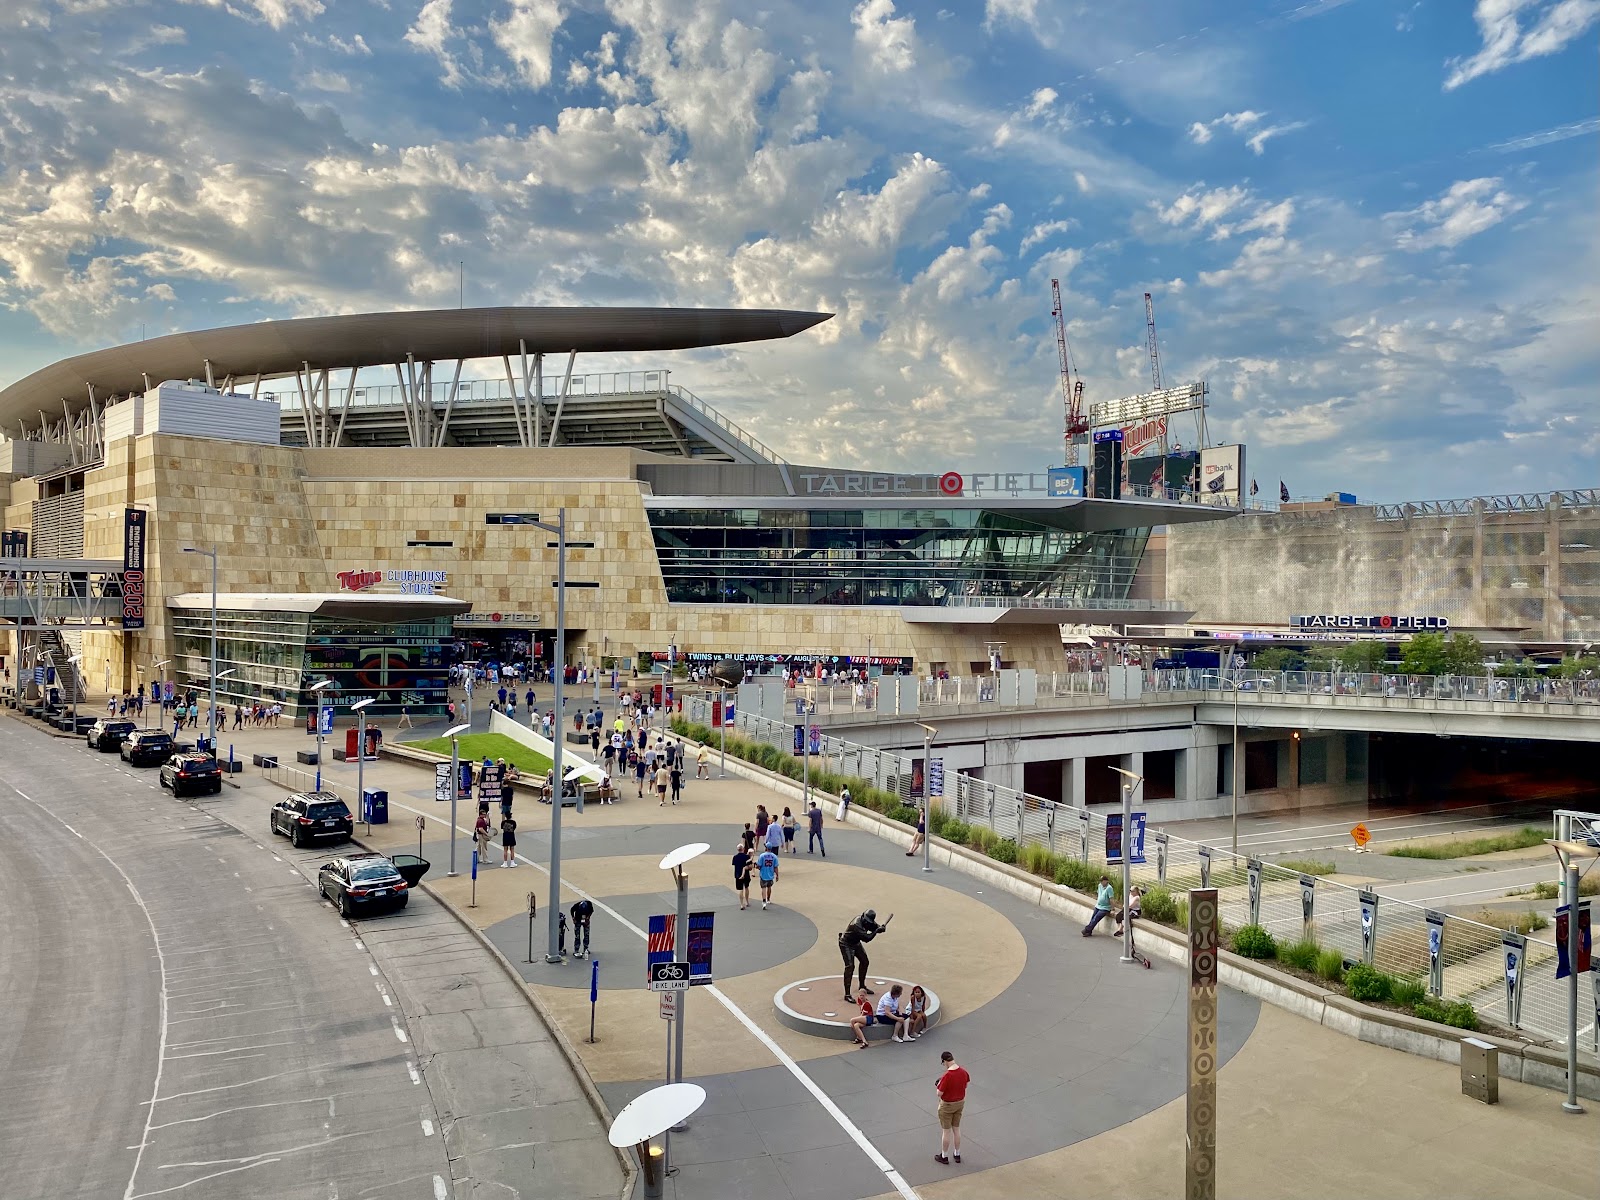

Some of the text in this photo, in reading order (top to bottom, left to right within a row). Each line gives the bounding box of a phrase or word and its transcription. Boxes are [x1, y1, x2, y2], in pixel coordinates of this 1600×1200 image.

[1119, 415, 1167, 456] Twins
[800, 473, 1073, 492] TARGET FIELD
[133, 525, 141, 568] CHAMPIONS
[337, 569, 447, 591] Twins CLUBHOUSE
[124, 570, 144, 618] 2020
[400, 583, 434, 594] STORE
[503, 613, 540, 622] FIELD
[1300, 615, 1449, 628] TARGET FIELD
[688, 653, 713, 661] TWINS
[671, 981, 685, 989] LANE
[664, 995, 672, 1003] NO
